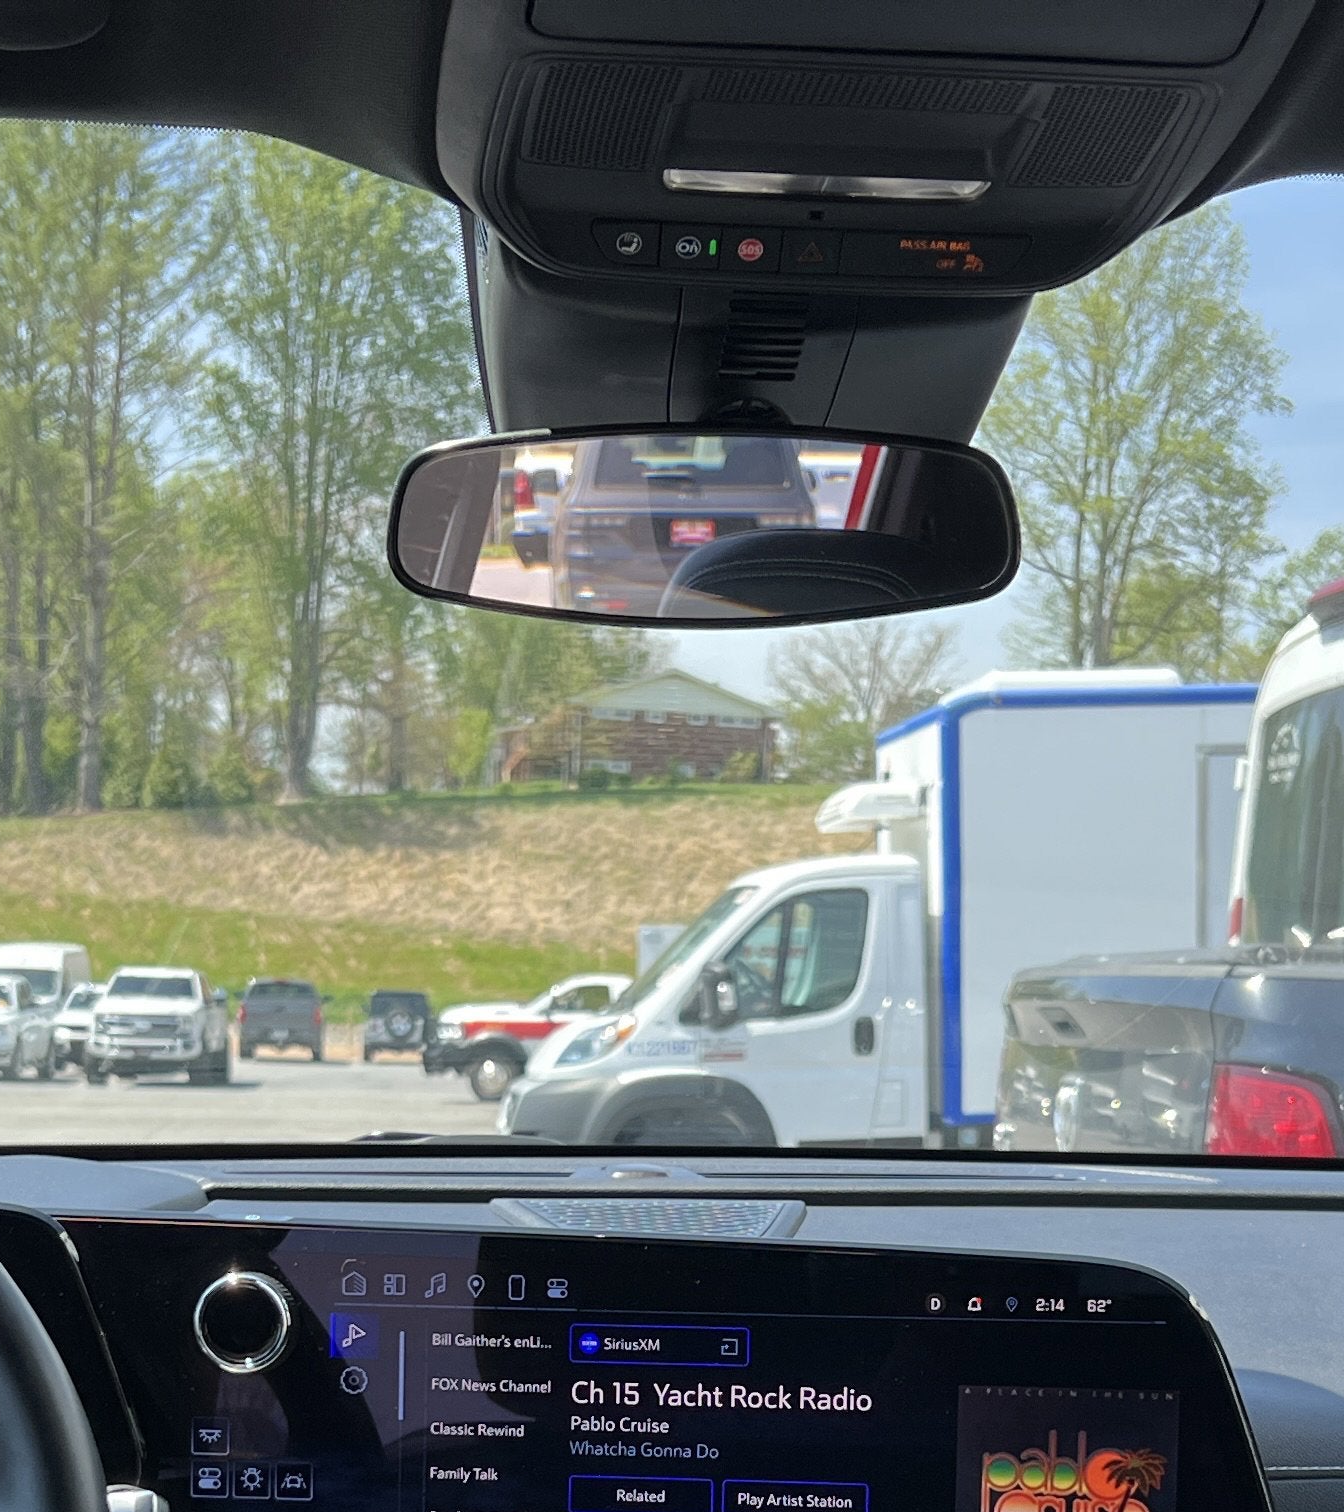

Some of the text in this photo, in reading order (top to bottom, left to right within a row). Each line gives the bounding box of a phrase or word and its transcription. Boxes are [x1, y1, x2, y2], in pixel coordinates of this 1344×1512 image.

[740, 244, 761, 255] SOS
[930, 1297, 941, 1311] D
[1035, 1298, 1112, 1313] 2:14 62°
[431, 1333, 452, 1347] Bill
[455, 1333, 511, 1348] Gaither's
[603, 1337, 661, 1352] SiriusXM
[431, 1378, 552, 1394] FOX News Channel
[571, 1380, 873, 1411] Ch 15 Yacht Rock Radio
[430, 1422, 525, 1438] Classic Rewind
[570, 1415, 670, 1433] Pablo Cruise
[569, 1440, 719, 1459] Whatcha Gonna Do
[429, 1467, 499, 1483] Family Talk
[616, 1489, 666, 1503] Related
[737, 1492, 853, 1510] Play Artist Station
